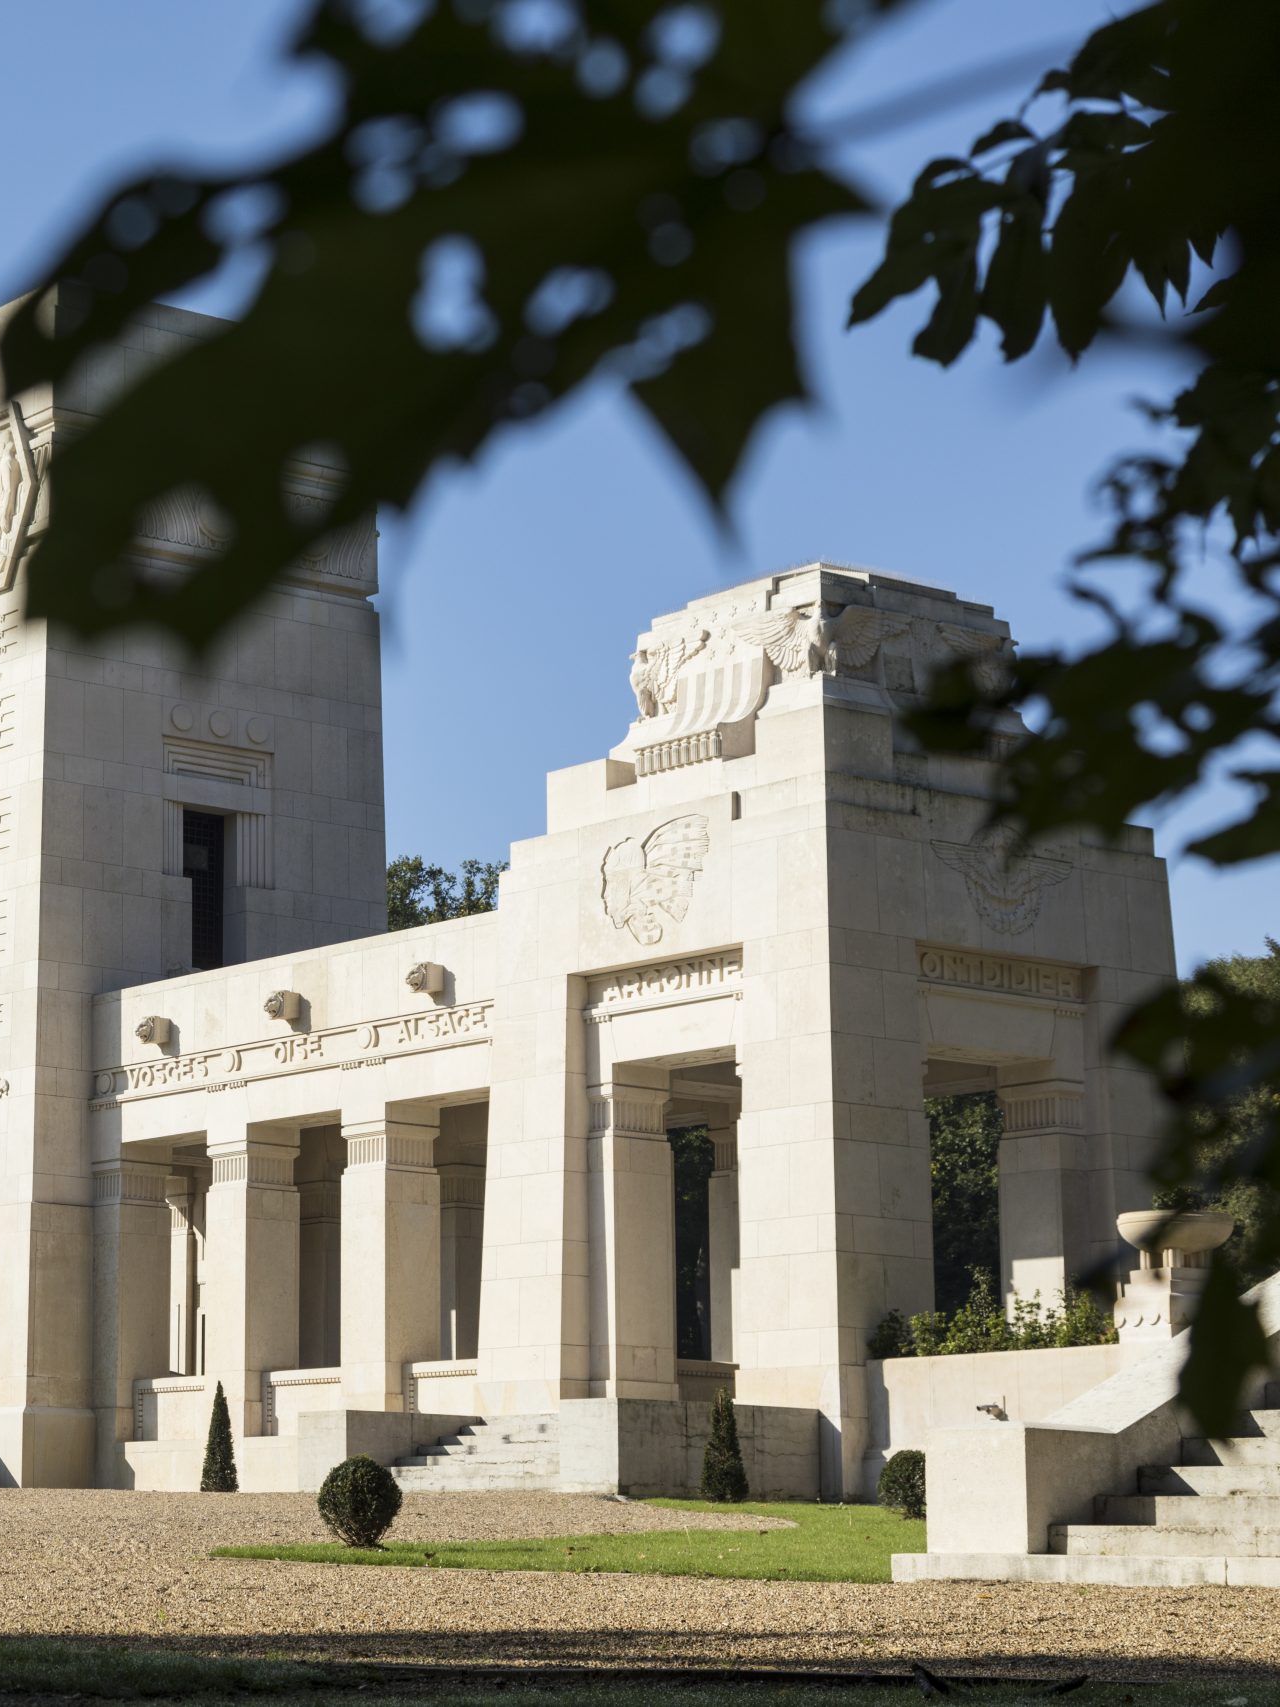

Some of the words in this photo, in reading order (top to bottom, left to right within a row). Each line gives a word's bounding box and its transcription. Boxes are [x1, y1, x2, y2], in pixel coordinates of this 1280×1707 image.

[603, 955, 743, 1001] ARGONNE
[126, 1056, 209, 1090] VOSGES
[273, 1035, 323, 1064] OISE
[398, 1007, 487, 1044] ALSACE
